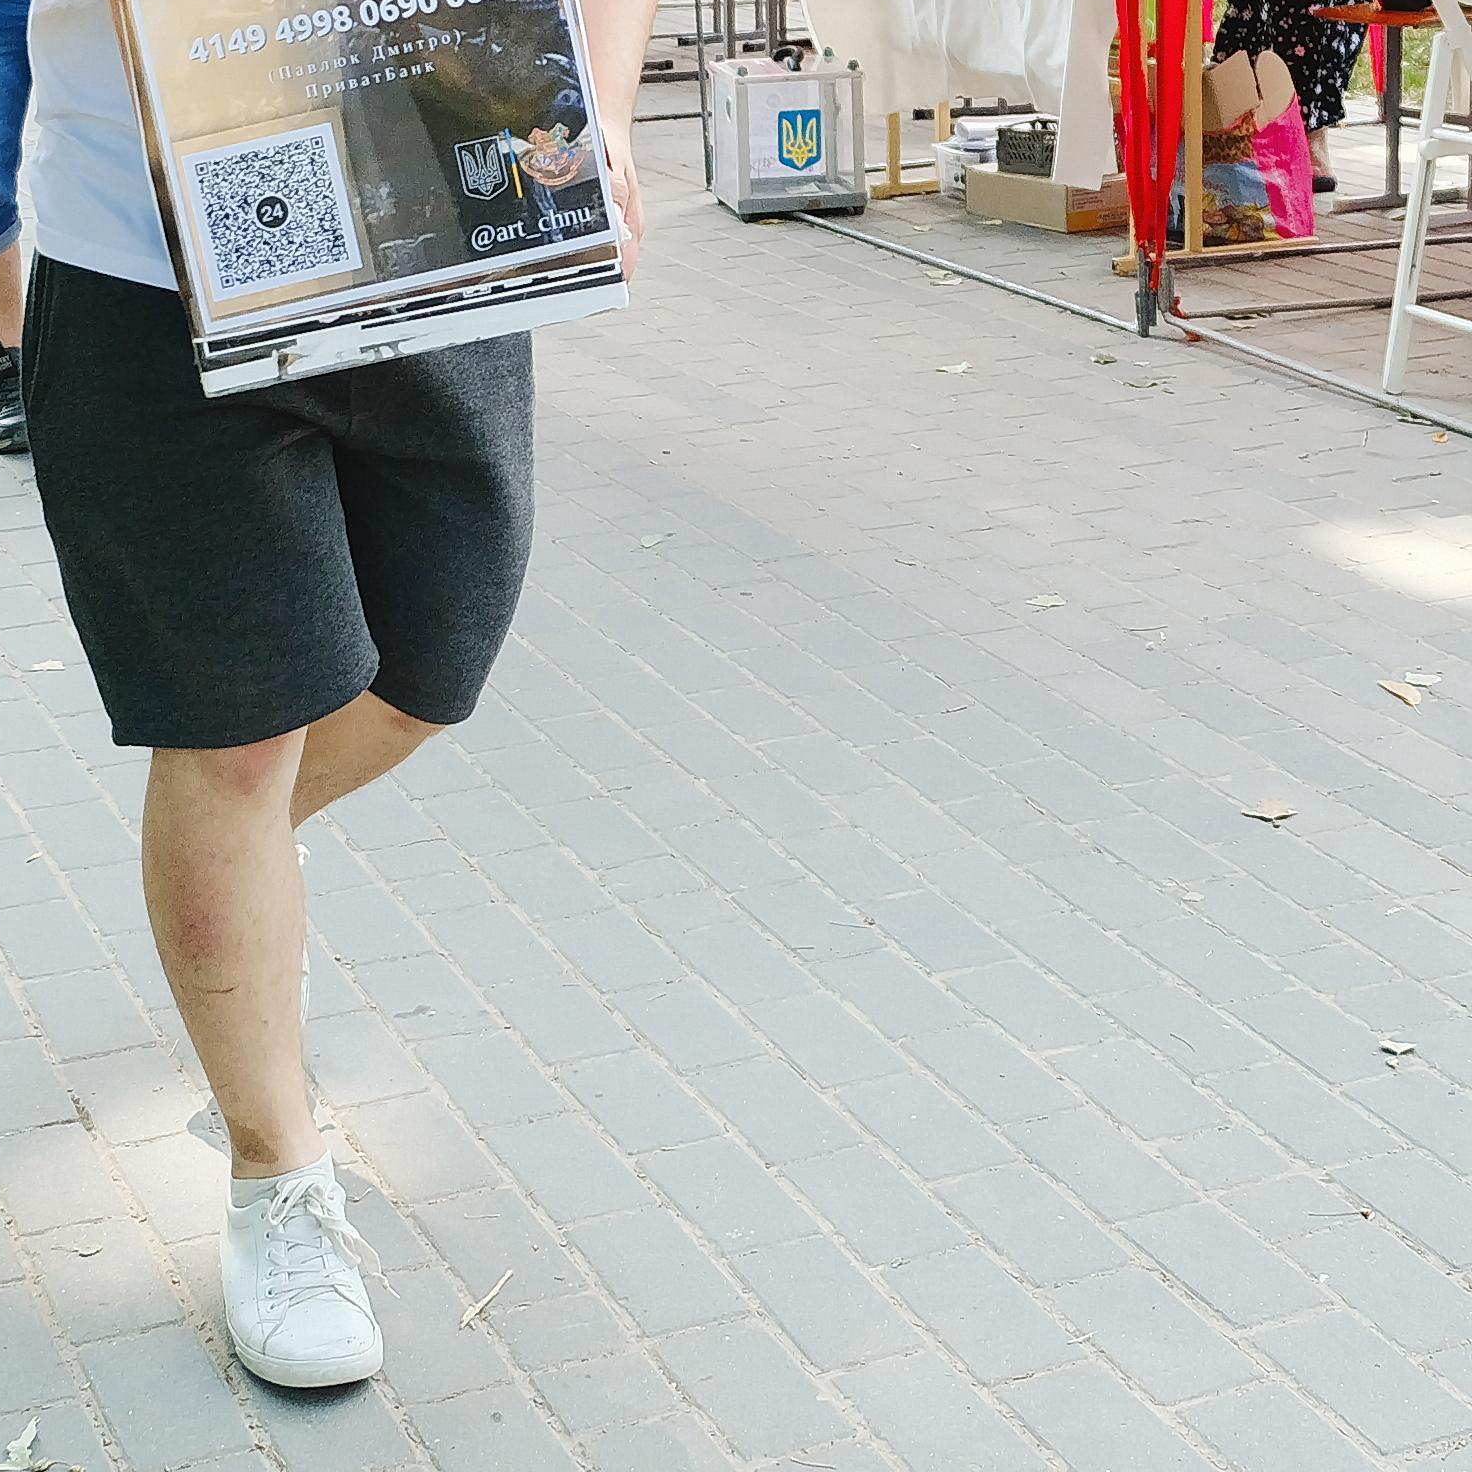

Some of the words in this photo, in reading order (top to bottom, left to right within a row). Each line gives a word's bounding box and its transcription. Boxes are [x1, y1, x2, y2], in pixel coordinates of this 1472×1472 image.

[189, 24, 267, 64] 4149
[275, 5, 354, 44] 4998
[371, 27, 463, 64] Дмитро)
[305, 60, 437, 99] ПриватБанк
[261, 204, 284, 223] 24
[472, 204, 592, 251] @art_chnu
